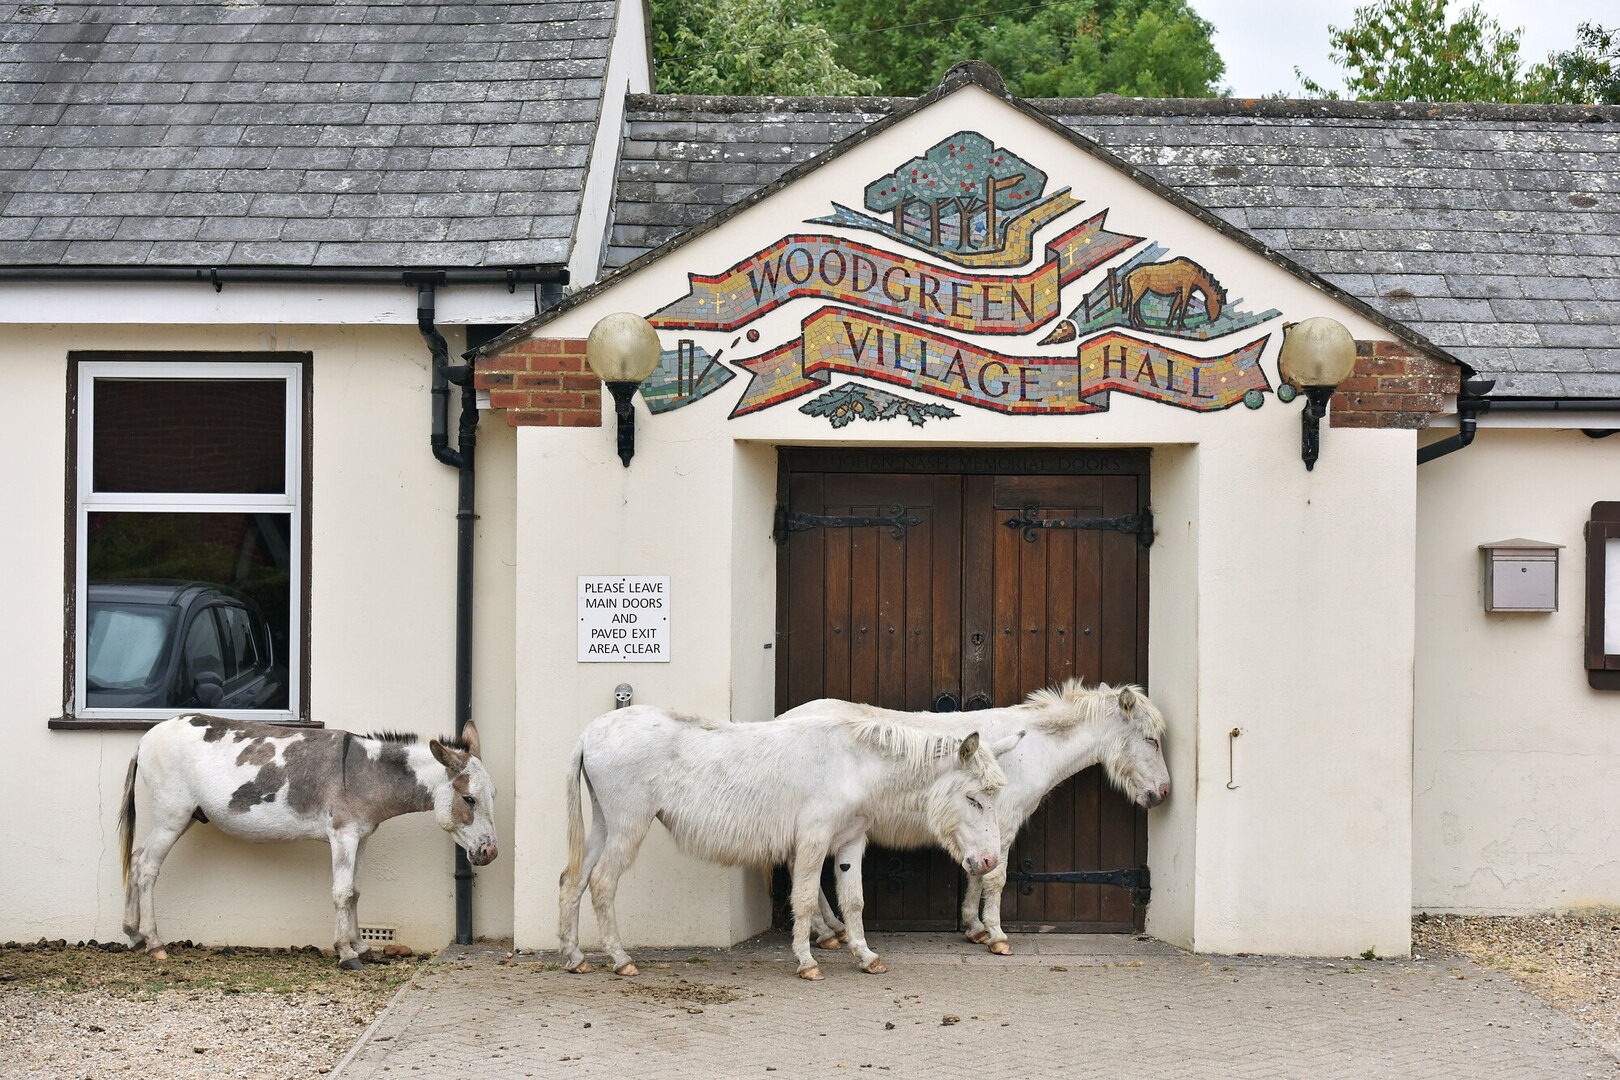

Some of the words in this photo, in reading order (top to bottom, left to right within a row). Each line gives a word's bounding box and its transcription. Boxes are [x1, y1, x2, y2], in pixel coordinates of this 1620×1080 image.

[746, 247, 1037, 324] WOODGREEN
[842, 320, 1044, 402] VILLAGE
[1101, 344, 1213, 398] HALL
[903, 456, 949, 470] NASH
[959, 456, 1049, 471] MEMORIAL
[1058, 457, 1121, 471] DOORS
[585, 583, 625, 593] PLEASE
[629, 583, 663, 593] LEAVE
[585, 598, 617, 608] MAIN
[622, 598, 662, 608] DOORS
[611, 614, 638, 623] AND
[591, 629, 627, 639] PAVED
[632, 629, 657, 639] EXIT
[588, 644, 620, 653] AREA
[624, 644, 661, 653] CLEAR
